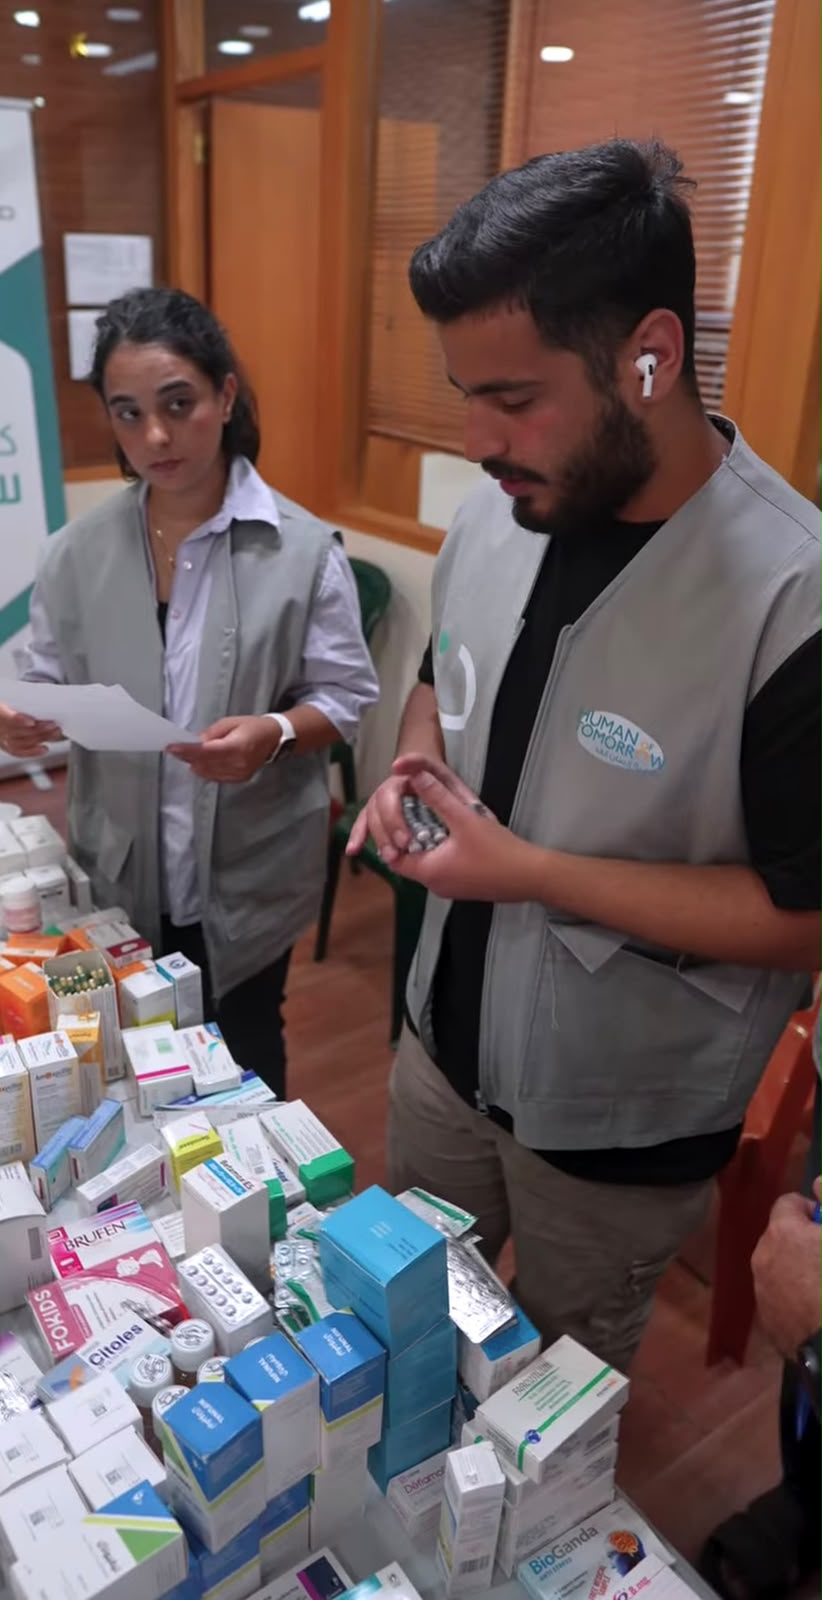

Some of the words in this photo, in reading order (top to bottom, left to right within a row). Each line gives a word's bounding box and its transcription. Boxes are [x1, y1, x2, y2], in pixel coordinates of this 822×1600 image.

[577, 721, 667, 770] OMORROW
[579, 708, 640, 746] HUMAN
[63, 1221, 127, 1251] BRUFEN
[34, 1289, 75, 1351] FOKIDS
[90, 1325, 144, 1366] Citoles
[529, 1525, 599, 1576] BioGanda
